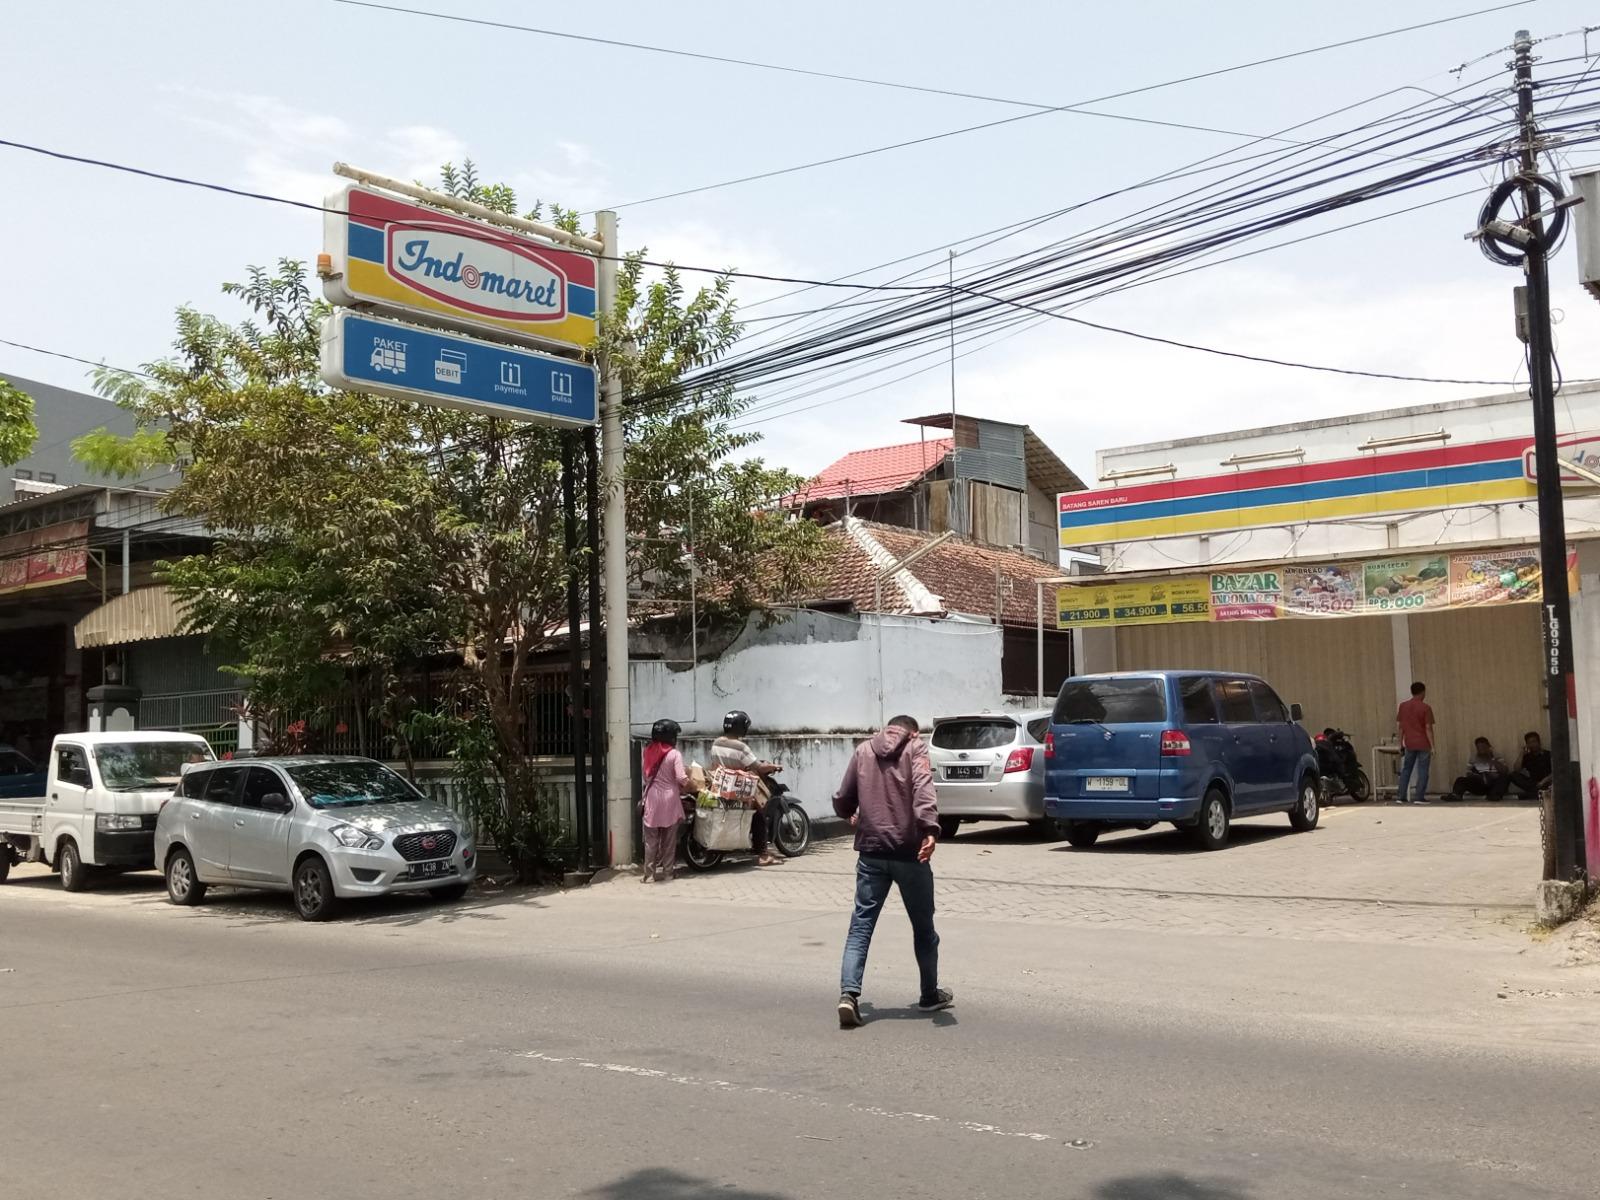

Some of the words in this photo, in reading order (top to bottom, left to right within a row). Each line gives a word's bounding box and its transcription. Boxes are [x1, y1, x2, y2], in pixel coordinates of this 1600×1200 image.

[398, 240, 557, 307] Indomaret
[373, 337, 408, 353] PAKET
[435, 366, 459, 378] DEBIT
[494, 384, 527, 396] payment
[551, 394, 573, 404] pulsa
[1062, 501, 1087, 510] BATANG
[1087, 499, 1109, 507] SAREN
[1211, 573, 1280, 592] BAZAR
[1212, 593, 1281, 604] INDOMARET
[1379, 595, 1424, 609] 8.000
[1069, 610, 1100, 620] 21.900
[1124, 606, 1157, 617] 34.900
[1099, 777, 1114, 786] 1159
[409, 865, 415, 873] W
[422, 862, 436, 873] 1438
